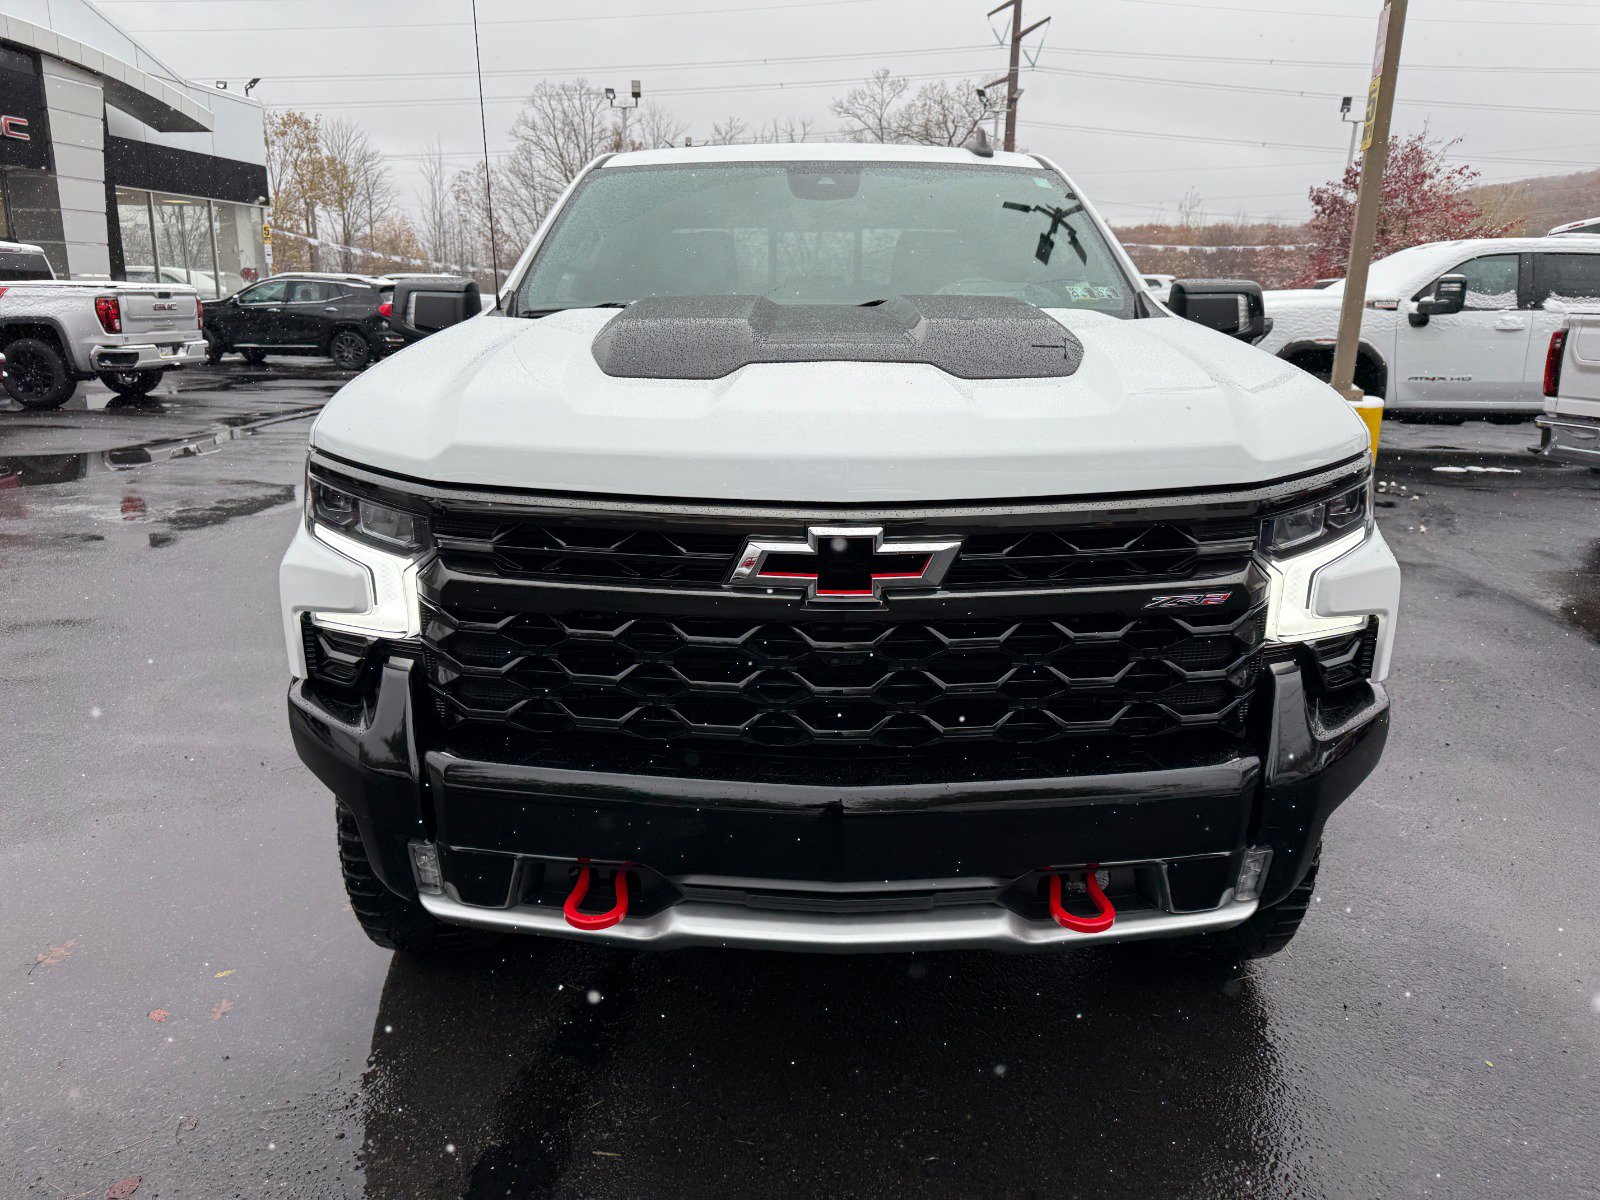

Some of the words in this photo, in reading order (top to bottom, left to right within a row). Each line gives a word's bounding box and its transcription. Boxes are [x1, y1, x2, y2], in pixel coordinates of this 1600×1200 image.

[0, 115, 31, 141] C
[263, 226, 270, 236] 5
[153, 302, 178, 311] GMC
[1142, 591, 1232, 609] ZR2
